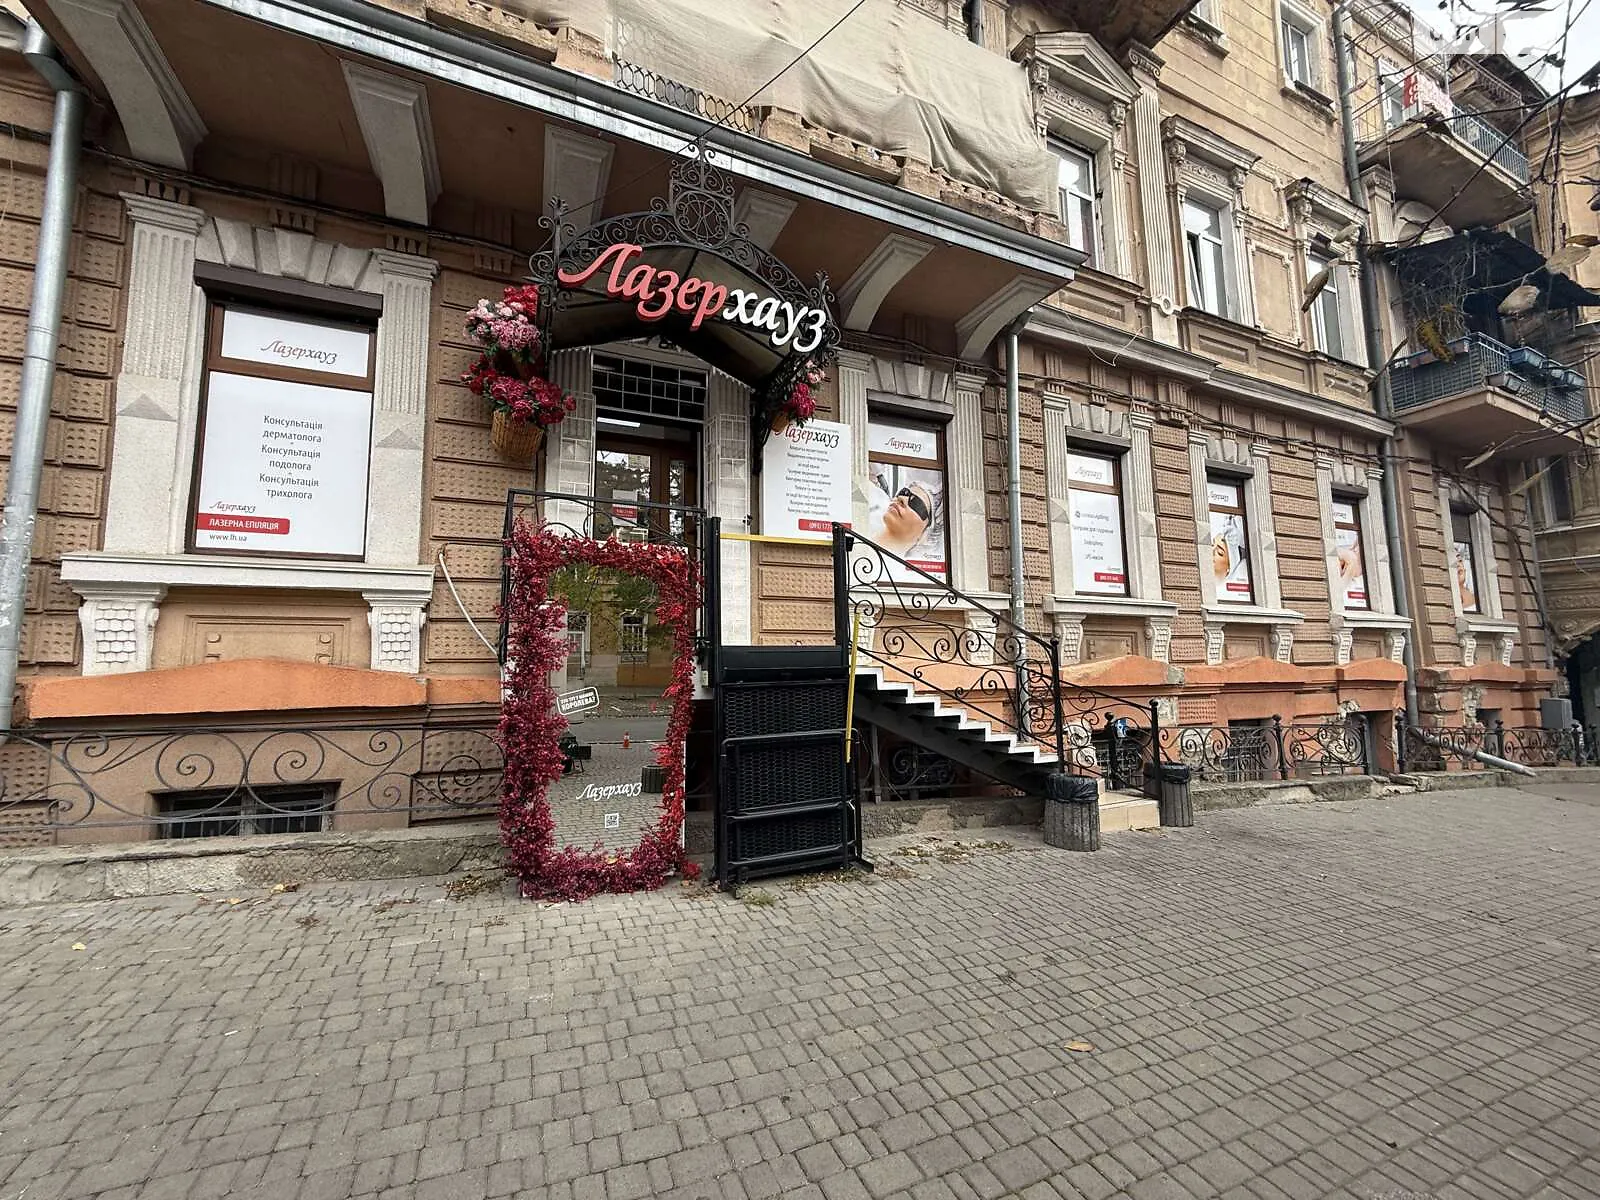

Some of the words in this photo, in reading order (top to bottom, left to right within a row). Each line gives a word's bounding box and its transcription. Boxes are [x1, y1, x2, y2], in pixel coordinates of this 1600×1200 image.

[557, 242, 827, 354] Лазерхауз
[260, 339, 338, 365] Лазерхауз
[263, 415, 323, 431] Консультація
[262, 429, 322, 444] дерматолога
[261, 444, 321, 459] Консультація
[269, 458, 312, 472] подолога
[259, 473, 319, 488] Консультація
[266, 487, 313, 501] трихолога
[209, 500, 256, 514] Лазерхауз
[208, 517, 244, 528] ЛАЗЕРНА
[245, 520, 279, 531] ЕПІЛЯЦІЯ
[209, 533, 247, 542] www.lh.ua
[576, 782, 643, 802] Лазерхауз
